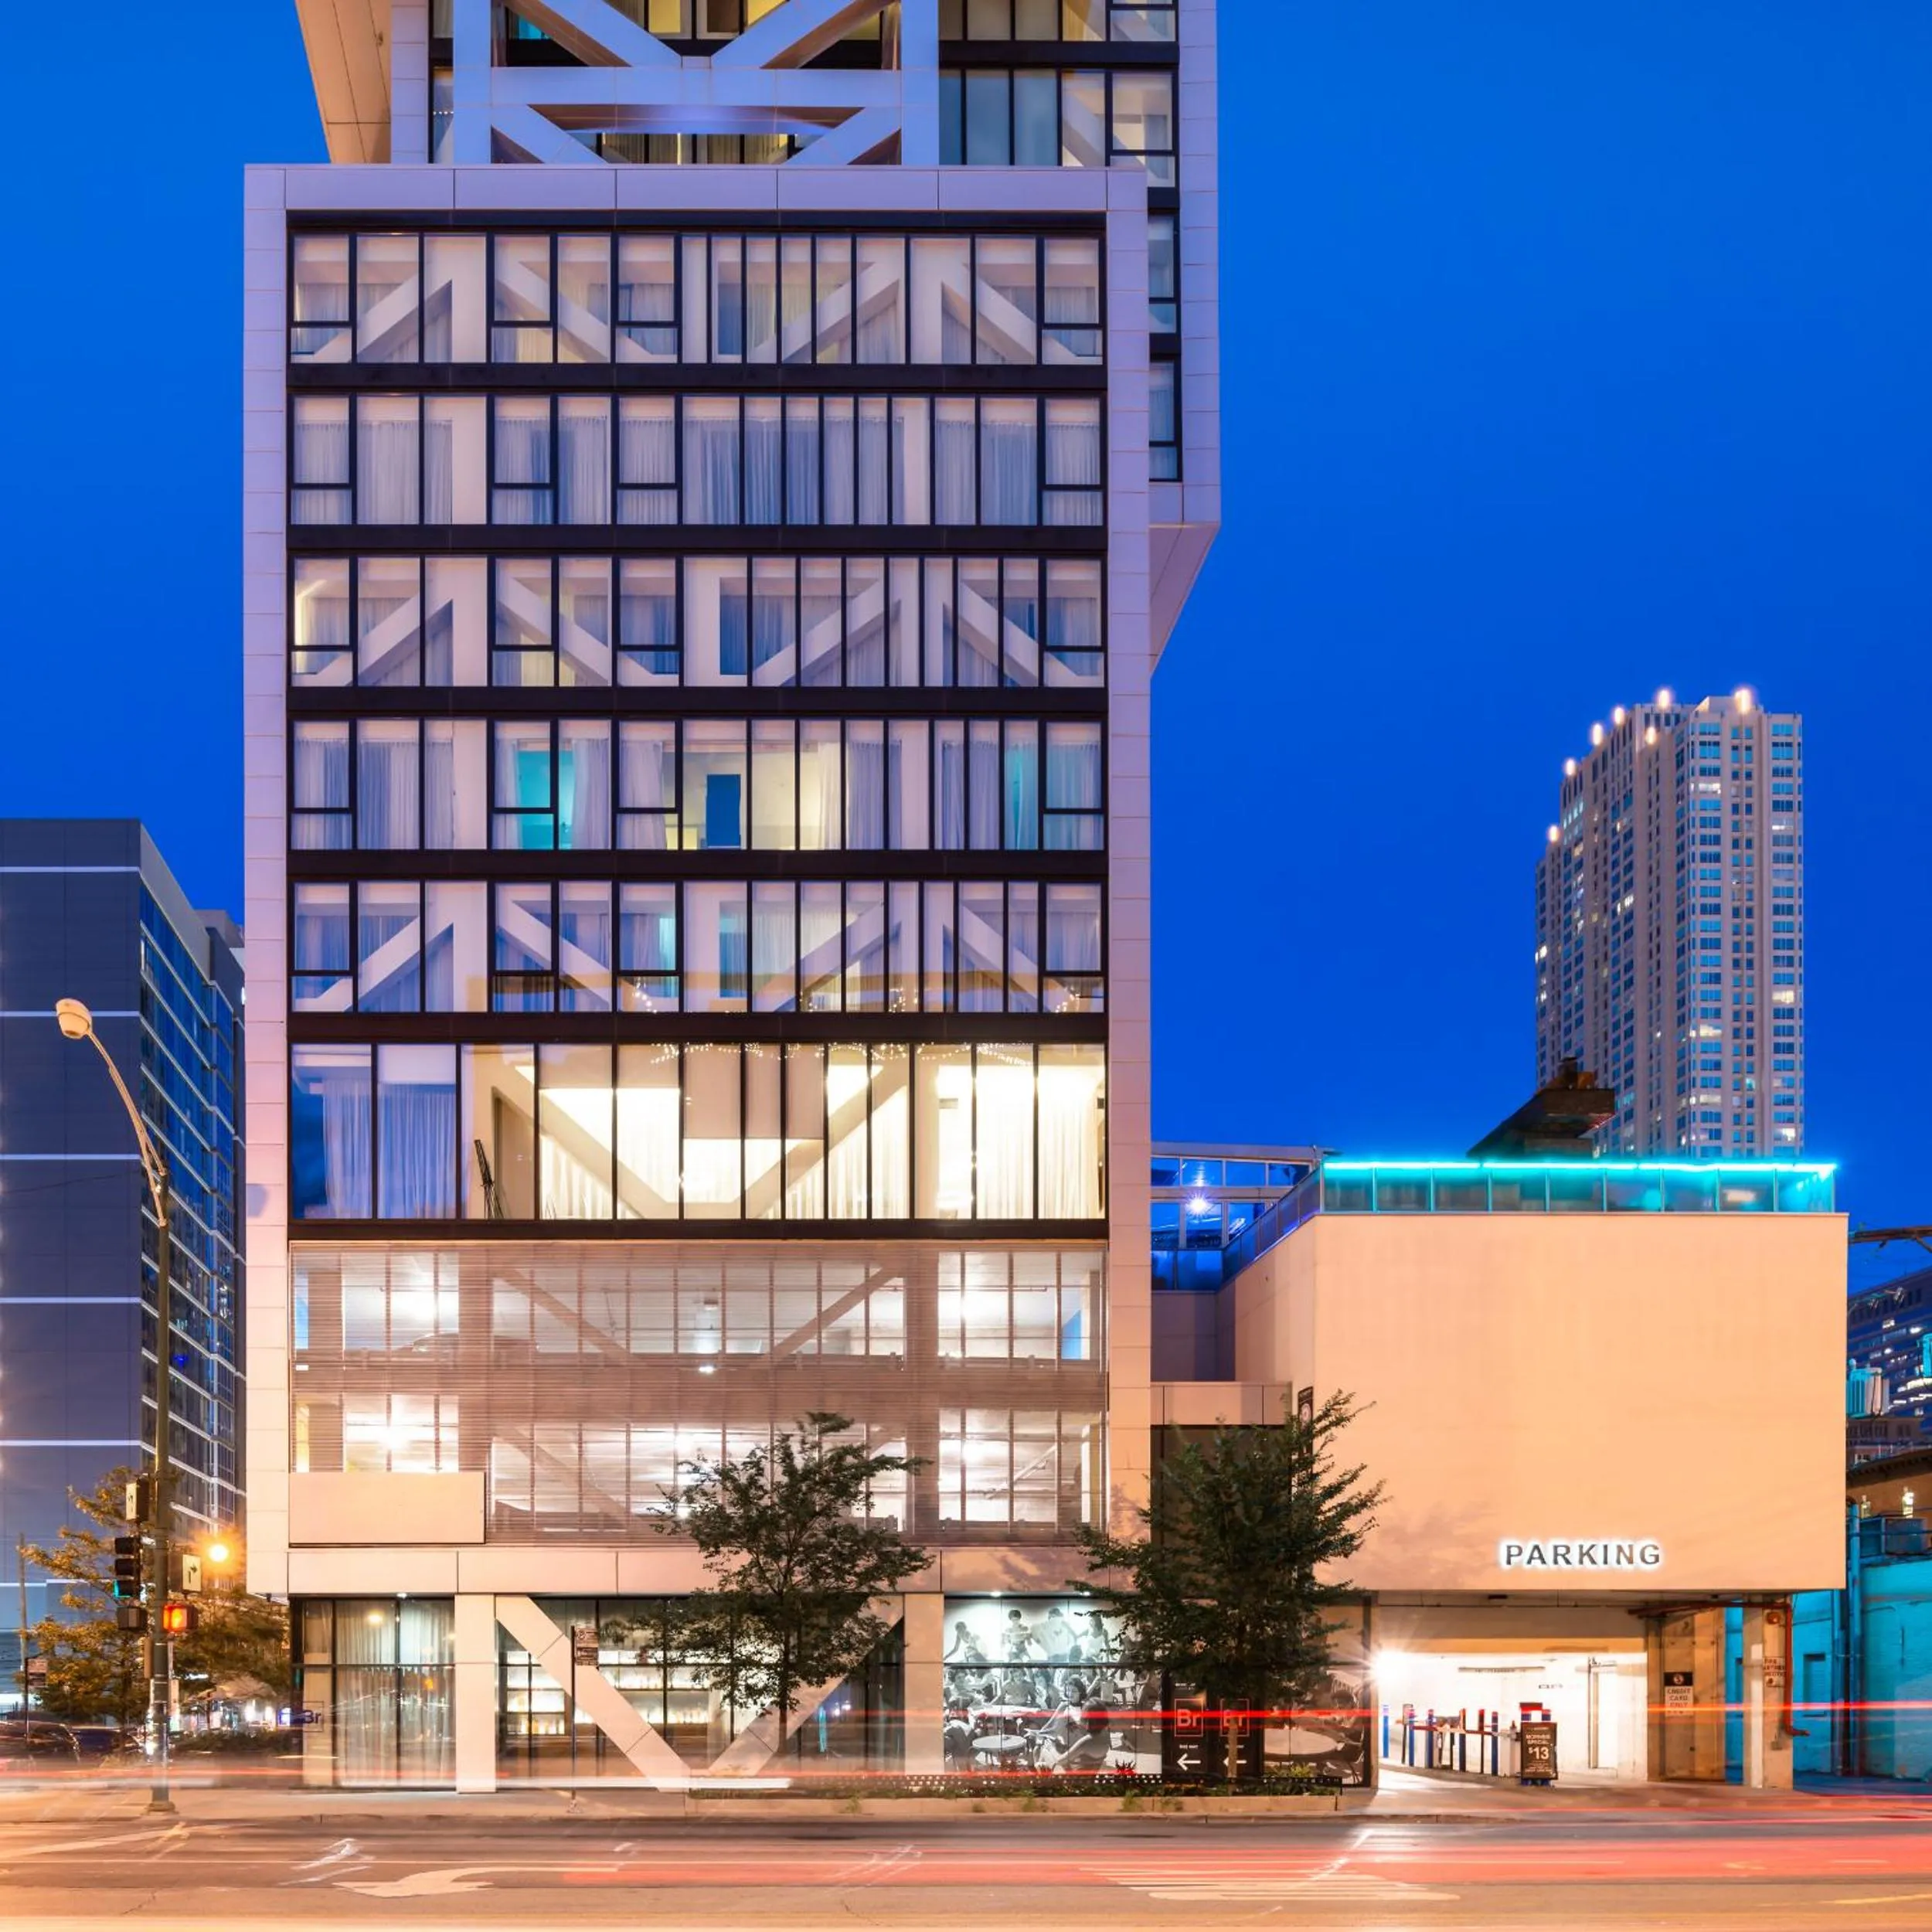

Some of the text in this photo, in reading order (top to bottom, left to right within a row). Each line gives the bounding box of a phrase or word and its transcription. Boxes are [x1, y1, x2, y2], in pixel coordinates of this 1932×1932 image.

[1505, 1543, 1660, 1566] PARKING
[1176, 1709, 1202, 1727] Br
[1528, 1747, 1549, 1760] $13
